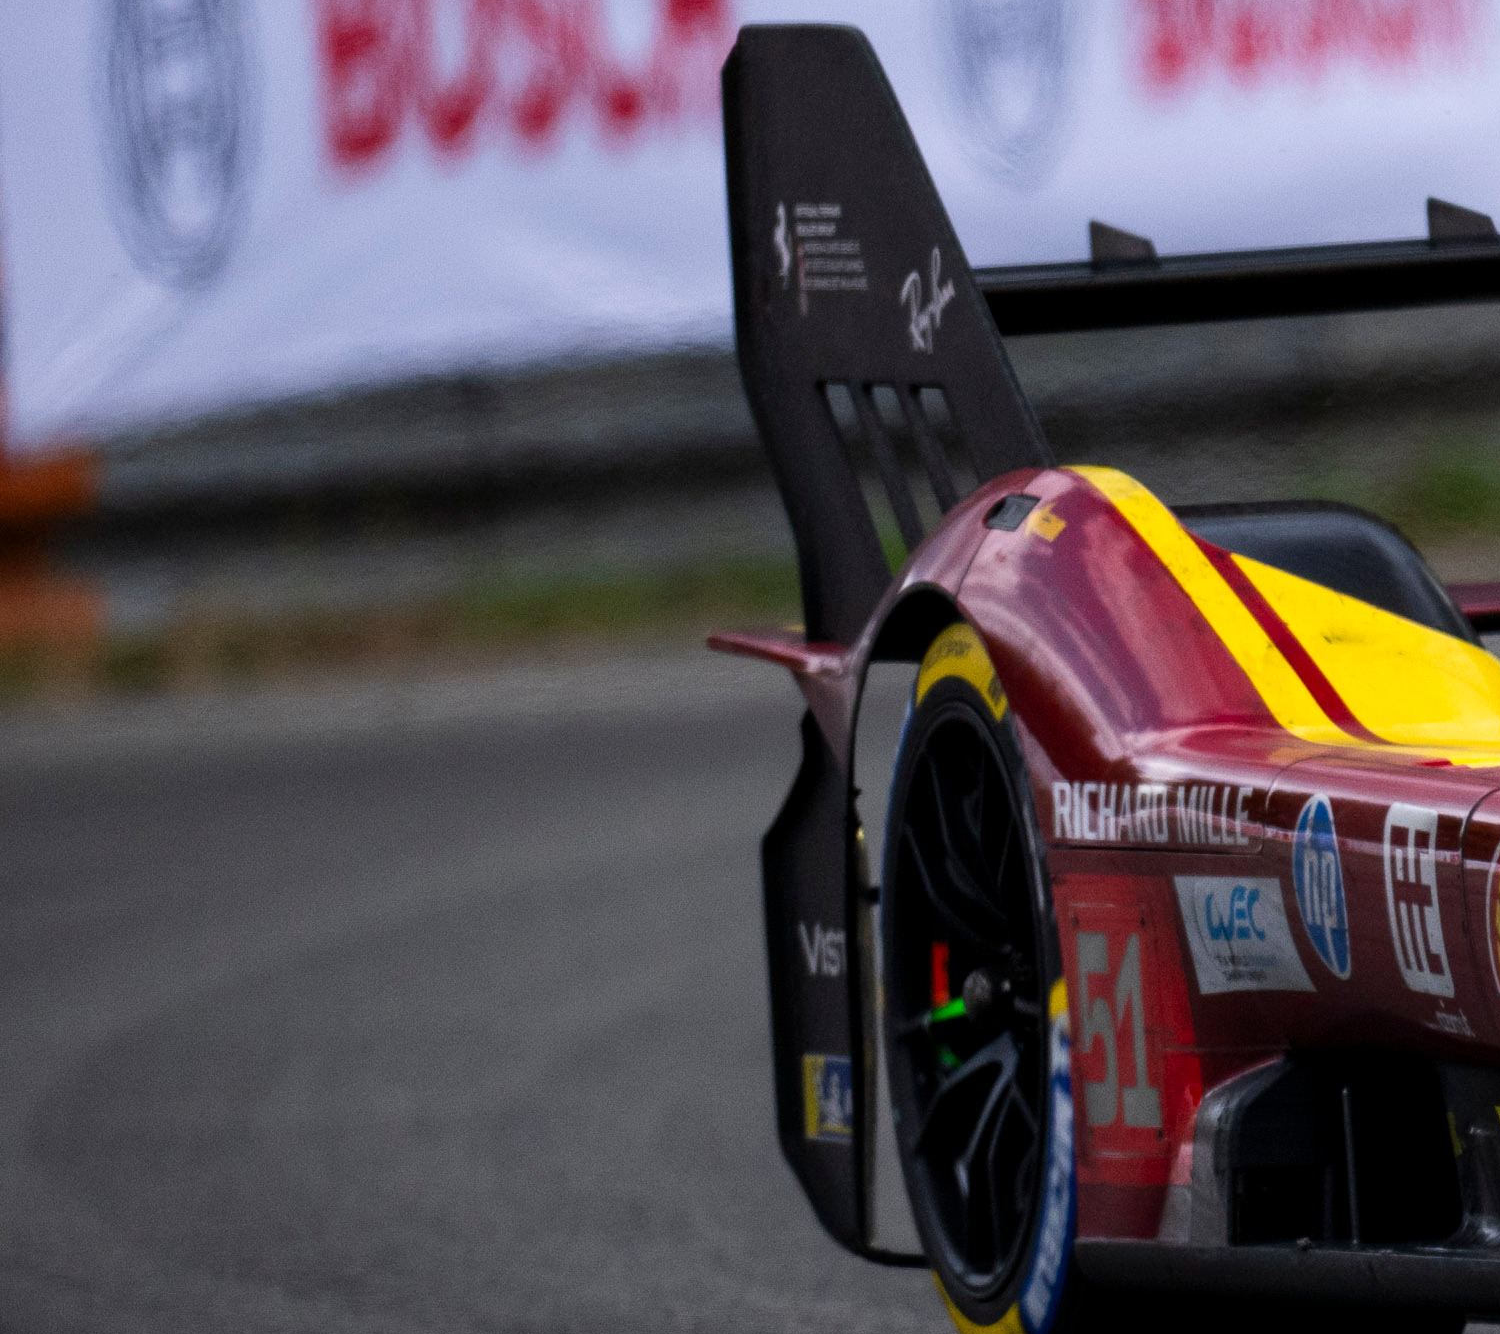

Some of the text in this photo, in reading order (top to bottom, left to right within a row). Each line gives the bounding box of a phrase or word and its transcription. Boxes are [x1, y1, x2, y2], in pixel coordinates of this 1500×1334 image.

[1052, 780, 1255, 846] RICHARD MILLE
[1205, 884, 1266, 943] WEC
[1077, 932, 1163, 1128] 51
